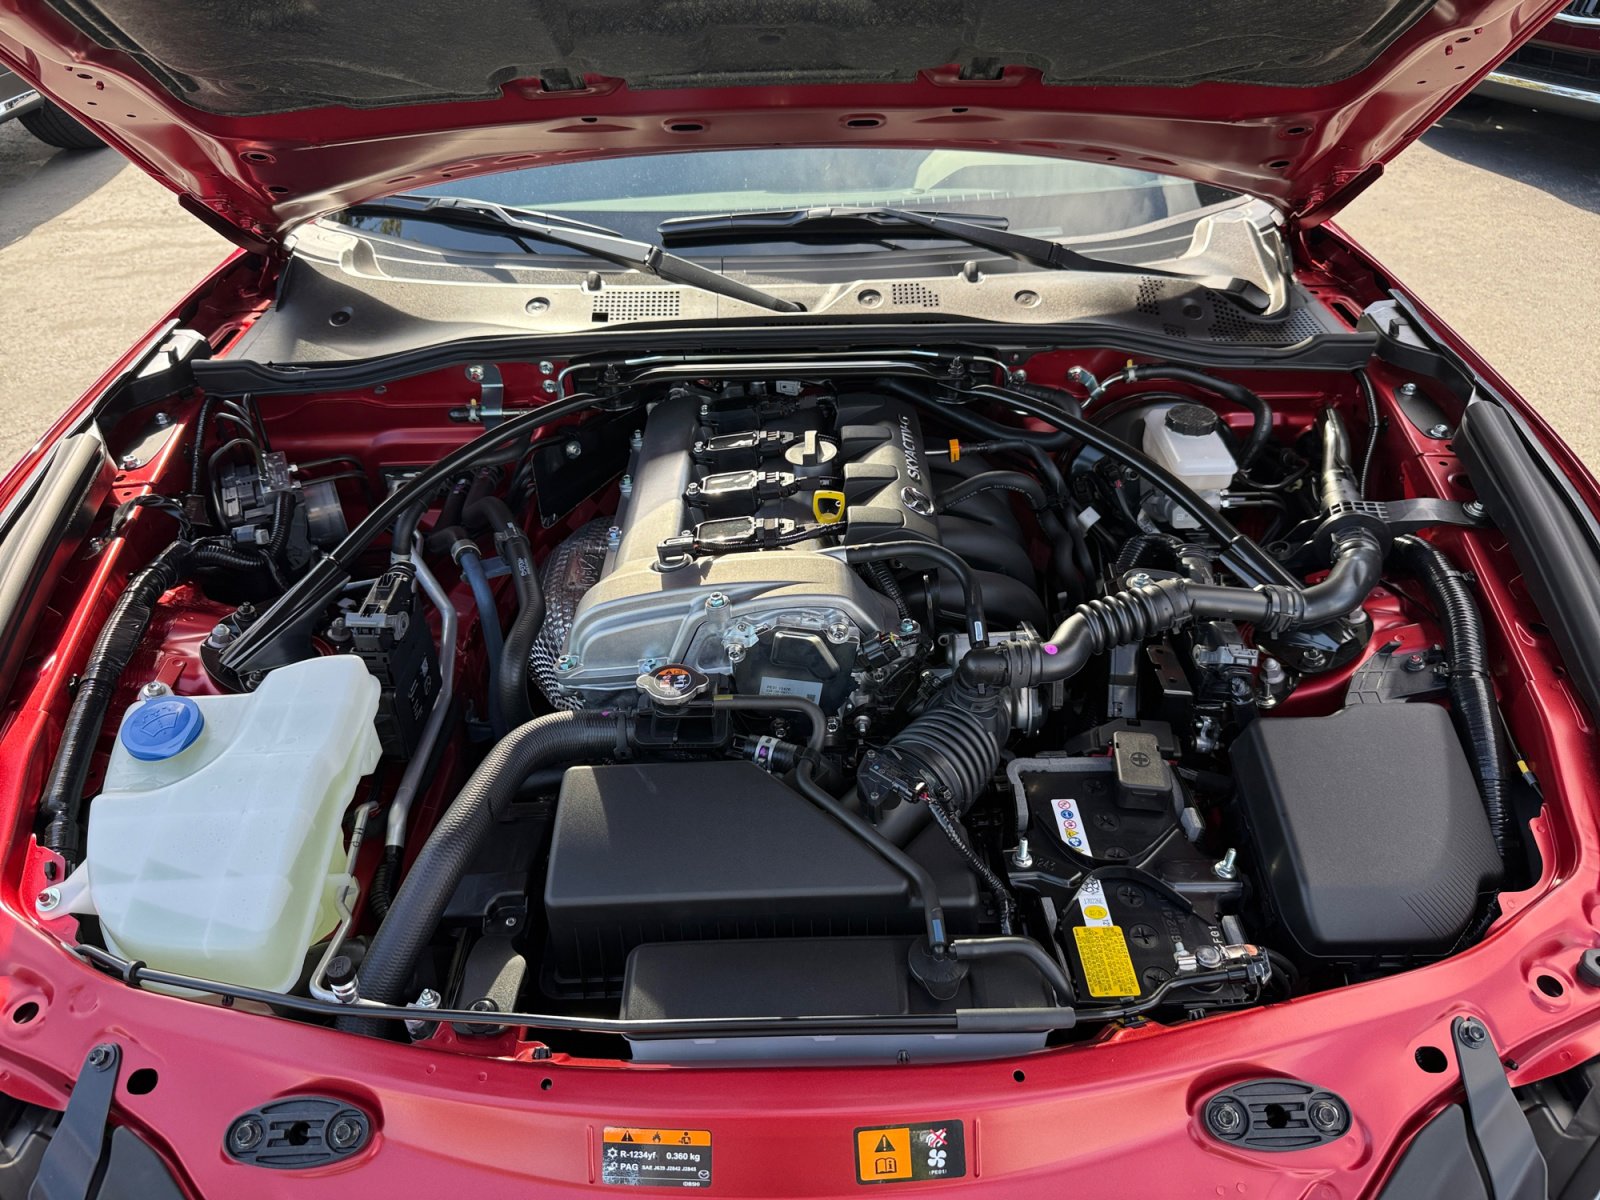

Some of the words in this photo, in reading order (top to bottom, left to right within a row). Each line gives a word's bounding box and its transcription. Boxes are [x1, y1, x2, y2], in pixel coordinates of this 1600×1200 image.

[620, 1150, 656, 1160] R-1234yf
[666, 1152, 688, 1160] 0.360
[689, 1153, 701, 1162] kg
[620, 1163, 639, 1171] PAG
